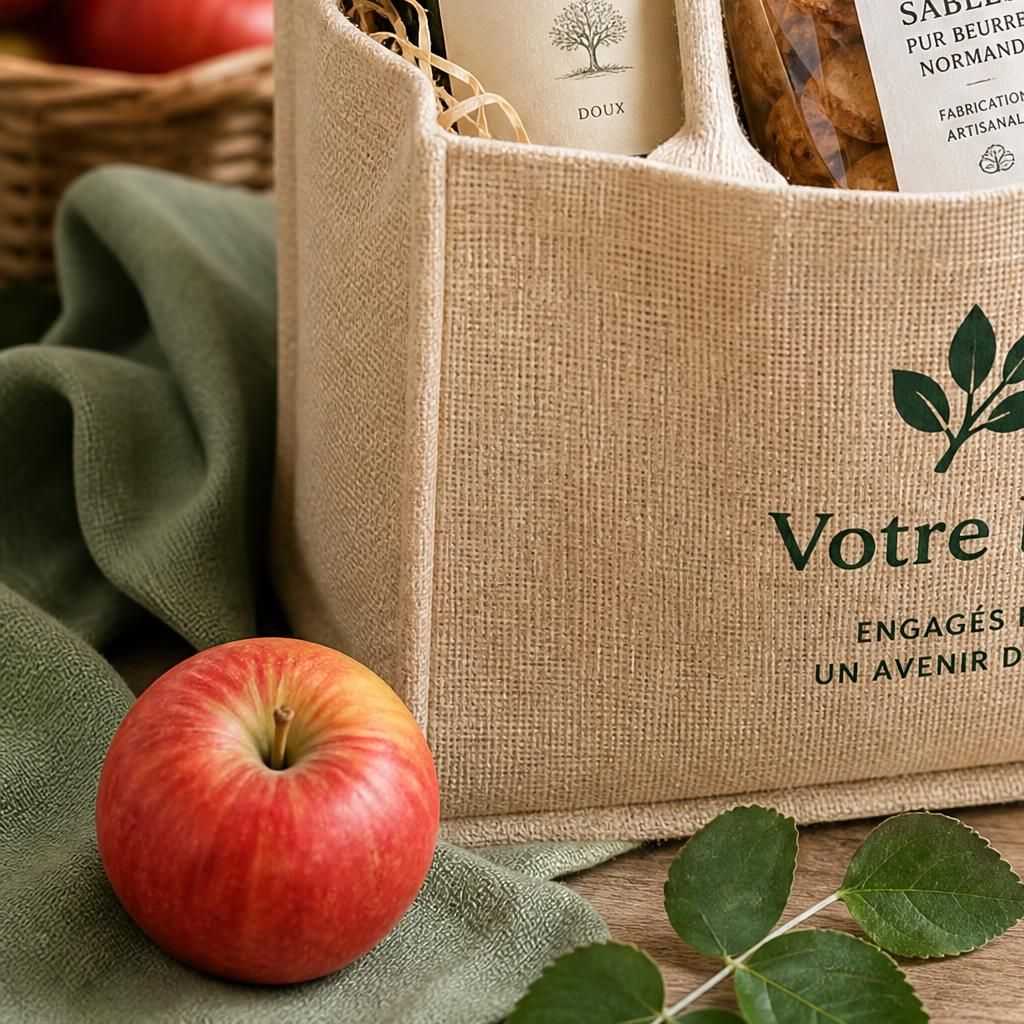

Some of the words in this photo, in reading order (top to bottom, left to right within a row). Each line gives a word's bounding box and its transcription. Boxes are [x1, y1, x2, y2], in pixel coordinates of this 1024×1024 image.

[906, 31, 947, 54] PUR
[920, 38, 1024, 77] NORMAND
[578, 102, 625, 120] DOUX
[769, 512, 990, 572] Votre
[857, 605, 1005, 643] ENGAGÉS
[815, 661, 858, 685] UN
[872, 651, 988, 682] AVENIR
